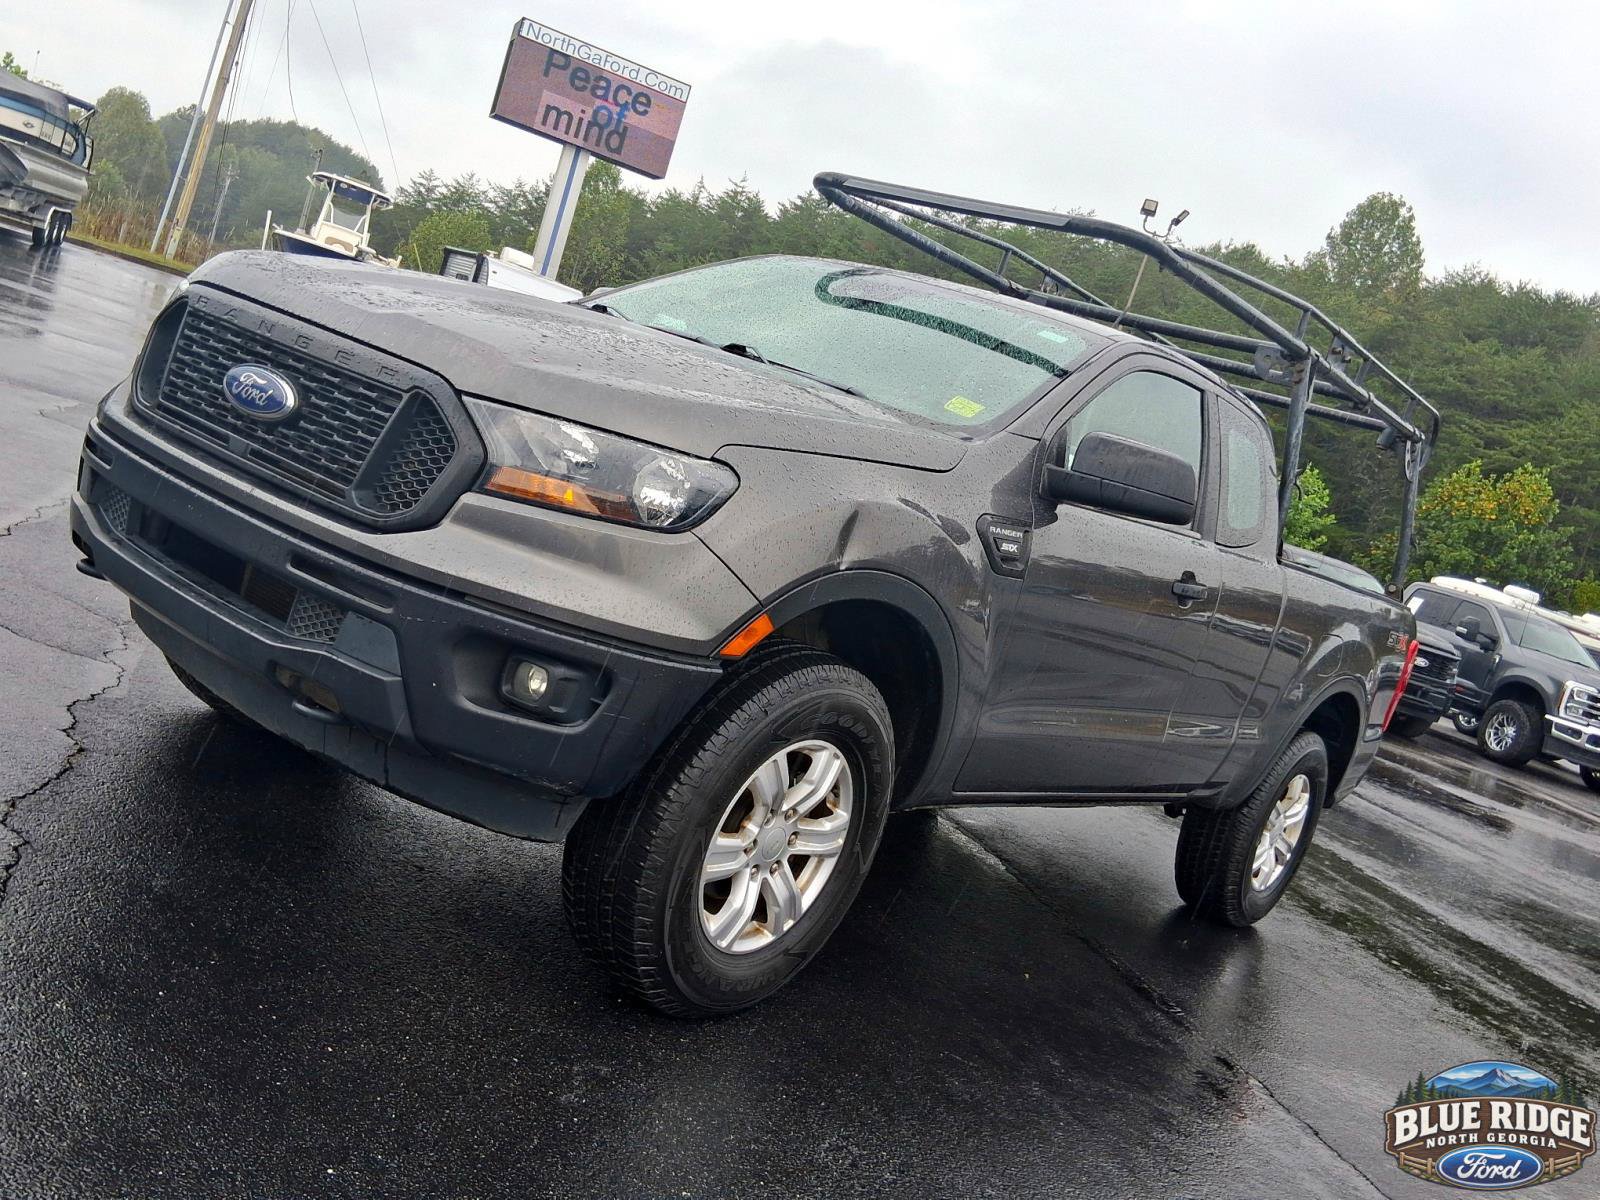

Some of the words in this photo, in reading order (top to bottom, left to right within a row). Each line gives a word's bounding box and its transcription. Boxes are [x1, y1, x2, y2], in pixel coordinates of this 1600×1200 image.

[526, 22, 684, 98] NorthGaFord.Com
[543, 47, 652, 117] Peace
[541, 102, 629, 156] mind
[592, 102, 631, 130] of
[232, 372, 274, 406] Ford
[990, 526, 1023, 538] RANGER
